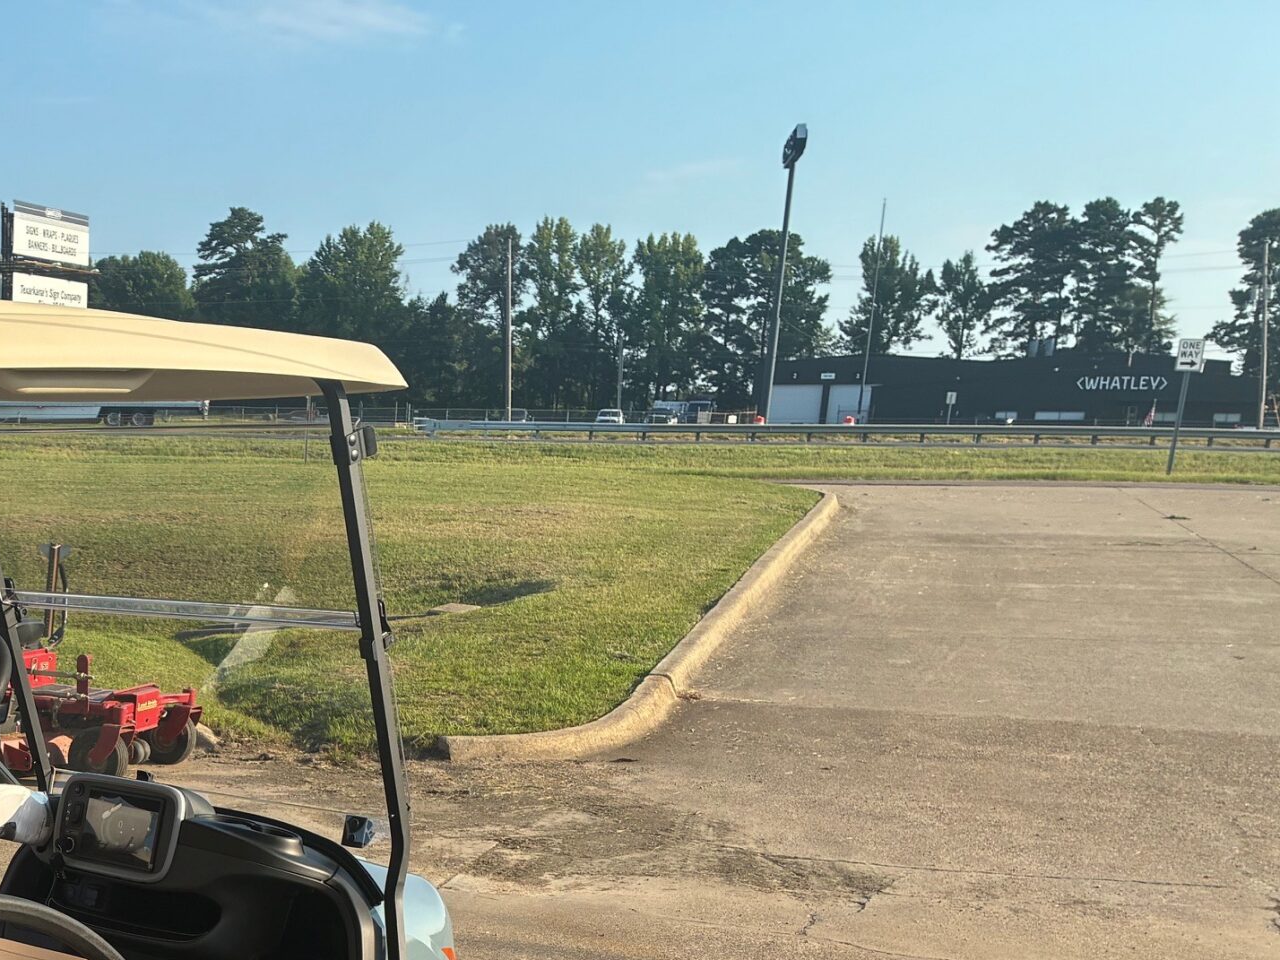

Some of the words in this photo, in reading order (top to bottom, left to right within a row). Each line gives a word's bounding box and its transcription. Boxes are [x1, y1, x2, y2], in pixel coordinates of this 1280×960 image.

[25, 225, 39, 236] SIGNS
[43, 228, 58, 240] WRAPS
[28, 239, 48, 252] BANNERS
[20, 284, 48, 298] Texarkana's
[49, 289, 60, 301] Sign
[61, 290, 82, 304] Company
[1182, 341, 1200, 350] ONE
[1180, 350, 1200, 358] WAY
